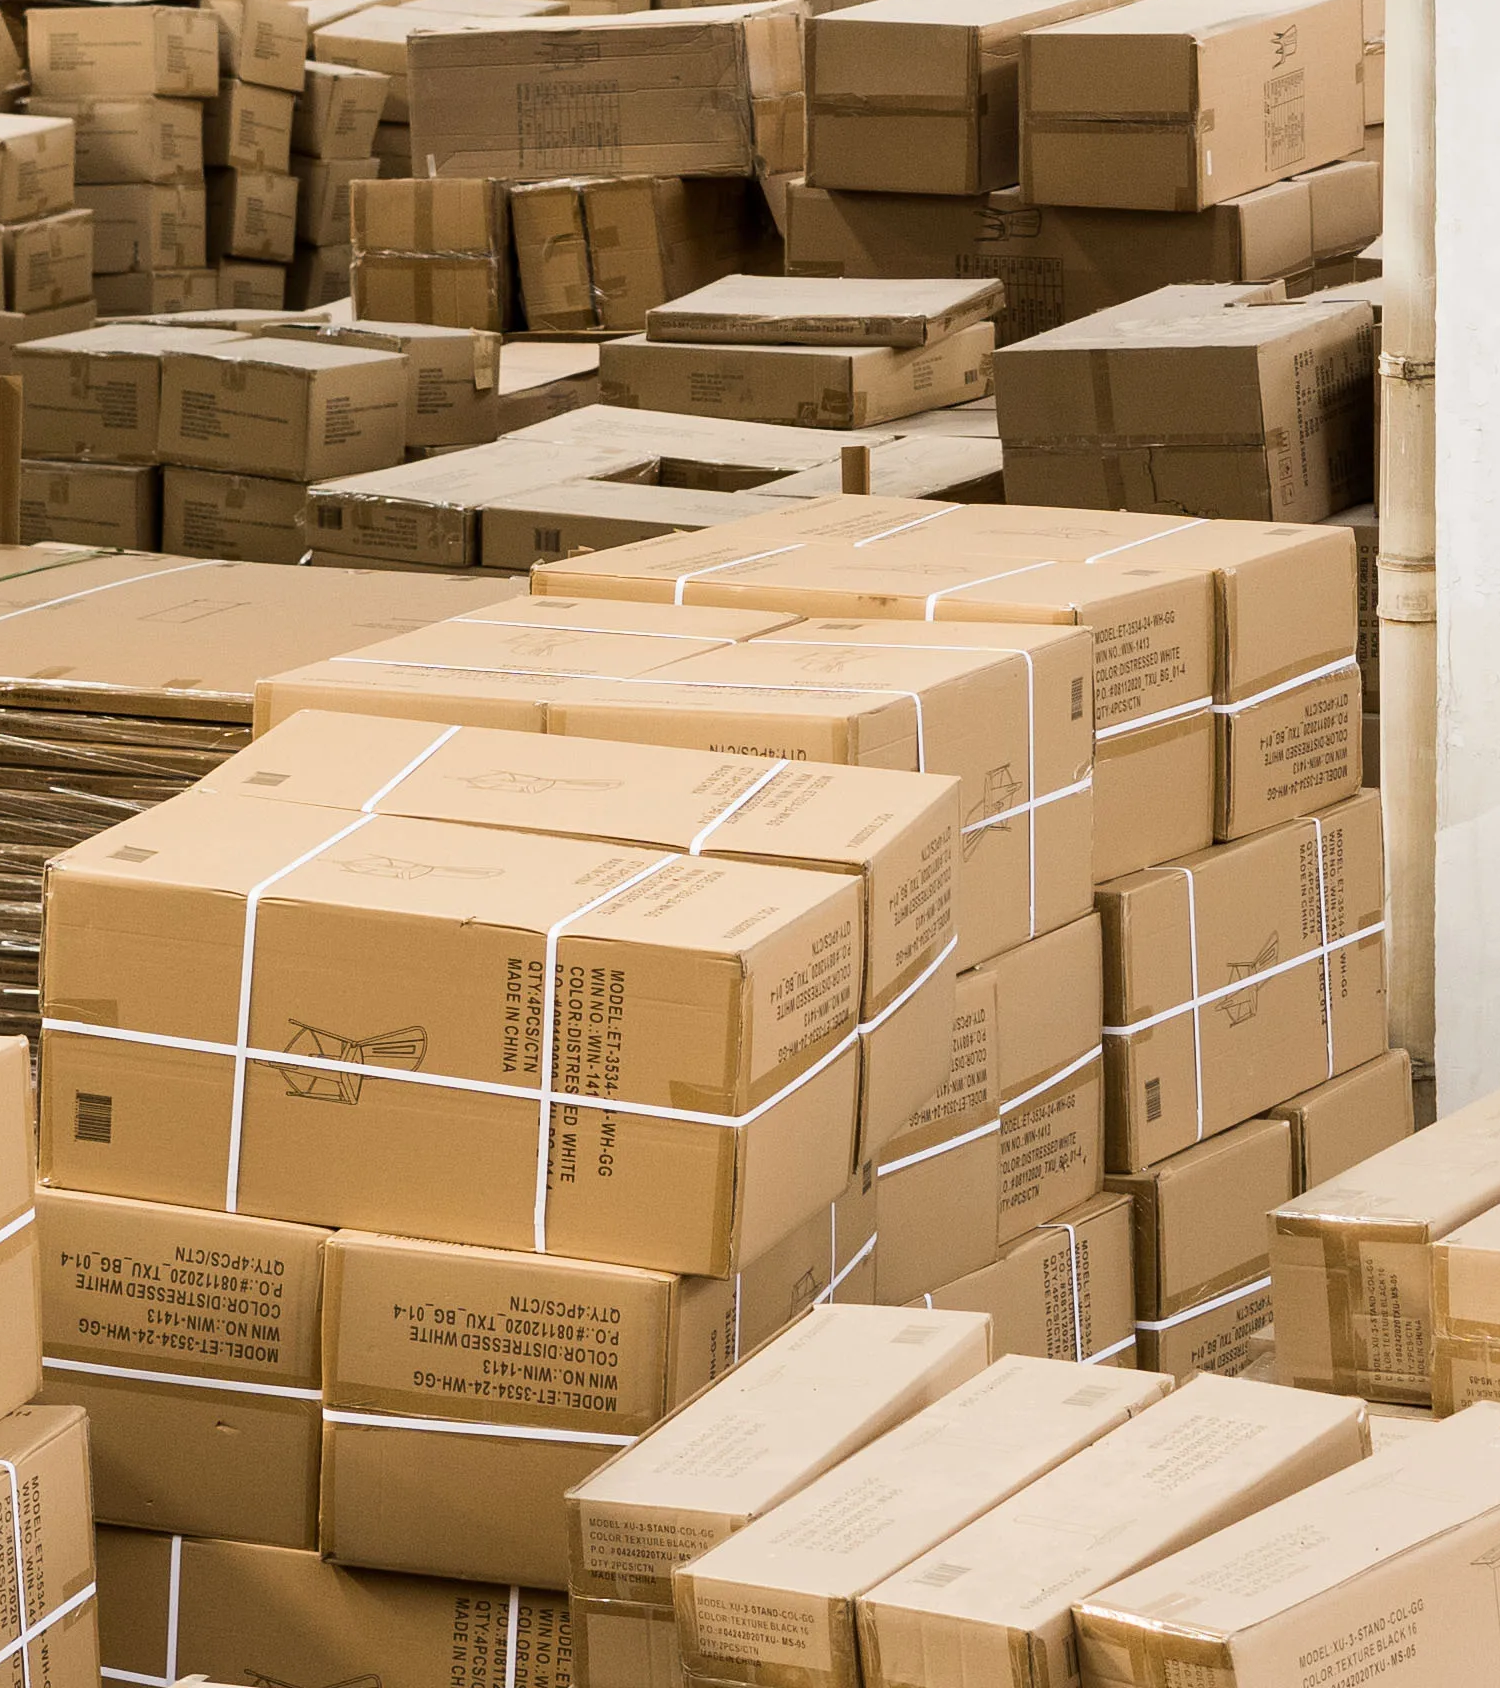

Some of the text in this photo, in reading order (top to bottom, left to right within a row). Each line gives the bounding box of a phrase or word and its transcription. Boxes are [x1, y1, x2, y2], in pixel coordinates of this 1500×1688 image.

[1161, 647, 1180, 663] WHITE
[503, 958, 522, 1072] MADE IN CHINA
[524, 961, 543, 1072] QTY:4PCS/CTN
[586, 968, 605, 1097] WIN NO.:WIN-141
[561, 967, 584, 1183] COLOR:DISTRESED WHITE
[176, 1246, 284, 1275] QTY:4PCS/CTN
[76, 1273, 281, 1319] COLOR:DISTRESSED WHITE
[510, 1296, 620, 1324] QTY:4PCS/CTN
[79, 1318, 279, 1362] MODEL:ET-3534-24-WH-GG
[252, 1325, 279, 1341] WIN
[410, 1326, 618, 1367] COLOR:DISTRESSED WHITE
[414, 1370, 617, 1411] MODEL:ET-3534-24-WH-GG
[589, 1374, 618, 1390] WIN
[22, 1482, 37, 1626] WIN NO.:WIN-141
[668, 1540, 696, 1549] BLACK
[591, 1570, 616, 1581] MADE
[629, 1574, 656, 1584] CHINA
[452, 1597, 470, 1661] MADE IN
[538, 1609, 554, 1638] WIN
[771, 1622, 798, 1633] BLACK
[1377, 1628, 1406, 1652] BLACK
[1408, 1622, 1417, 1636] 16
